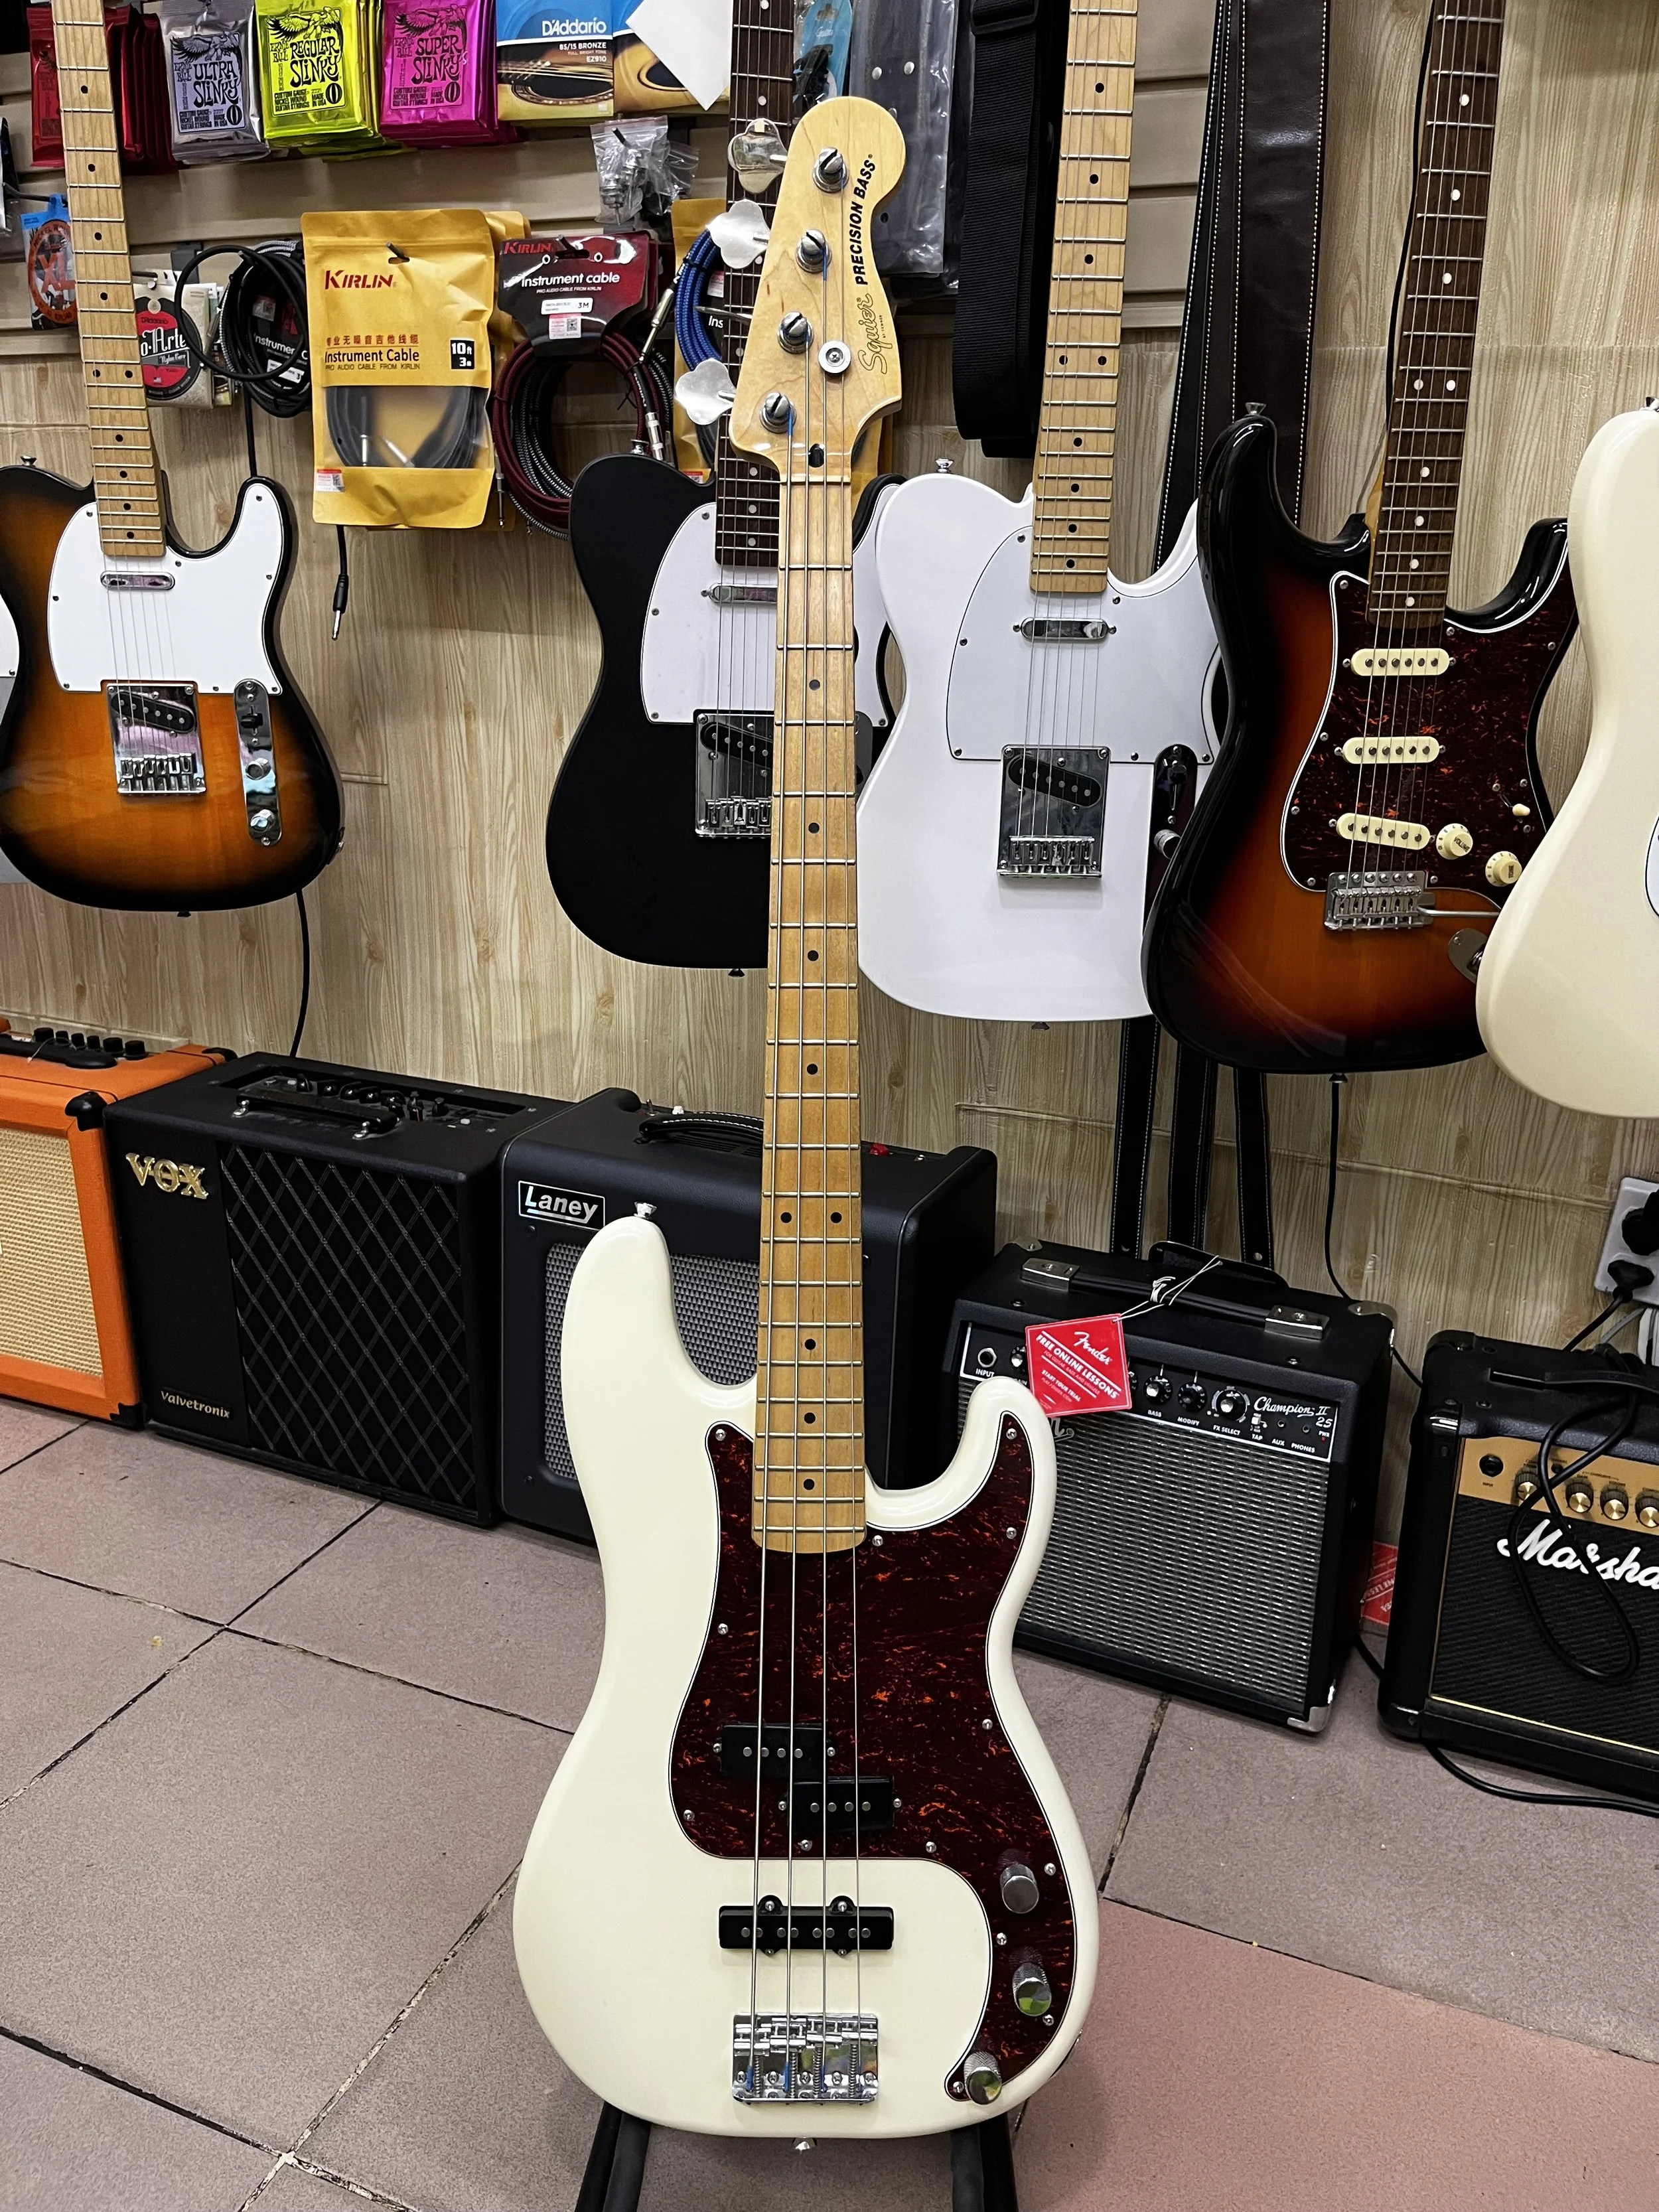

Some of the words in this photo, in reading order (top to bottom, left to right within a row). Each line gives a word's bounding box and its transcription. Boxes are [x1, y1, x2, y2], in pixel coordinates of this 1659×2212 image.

[542, 17, 607, 37] D'Addario
[290, 37, 339, 60] REGULAR
[415, 35, 462, 56] SUPER
[193, 60, 238, 80] ULTRA
[853, 159, 875, 200] BASS
[504, 242, 552, 255] KIRLIN
[849, 201, 868, 285] PRECISION
[325, 269, 394, 289] KIRLIN
[586, 271, 620, 283] cable
[858, 293, 893, 375] Squier
[325, 349, 384, 364] Instrument
[386, 348, 420, 362] Cable
[125, 1153, 209, 1199] VOX
[525, 1185, 599, 1224] Laney
[1074, 1331, 1112, 1365] Fender
[975, 1368, 995, 1378] INPUT
[1036, 1334, 1056, 1352] FREE
[1053, 1348, 1084, 1372] ONLINE
[1081, 1368, 1119, 1399] LESSONS
[1041, 1369, 1056, 1382] START
[1055, 1378, 1069, 1392] YOUR
[1067, 1388, 1081, 1402] TRIAL
[161, 1390, 230, 1419] Valvetronix
[1147, 1409, 1162, 1418] BASS
[1254, 1396, 1315, 1418] Champion
[1315, 1406, 1331, 1416] II
[1177, 1416, 1200, 1426] MODIFY
[1315, 1416, 1333, 1428] 25
[1221, 1427, 1241, 1436] SELECT
[1271, 1438, 1285, 1447] AUX
[1291, 1442, 1315, 1453] PHONES
